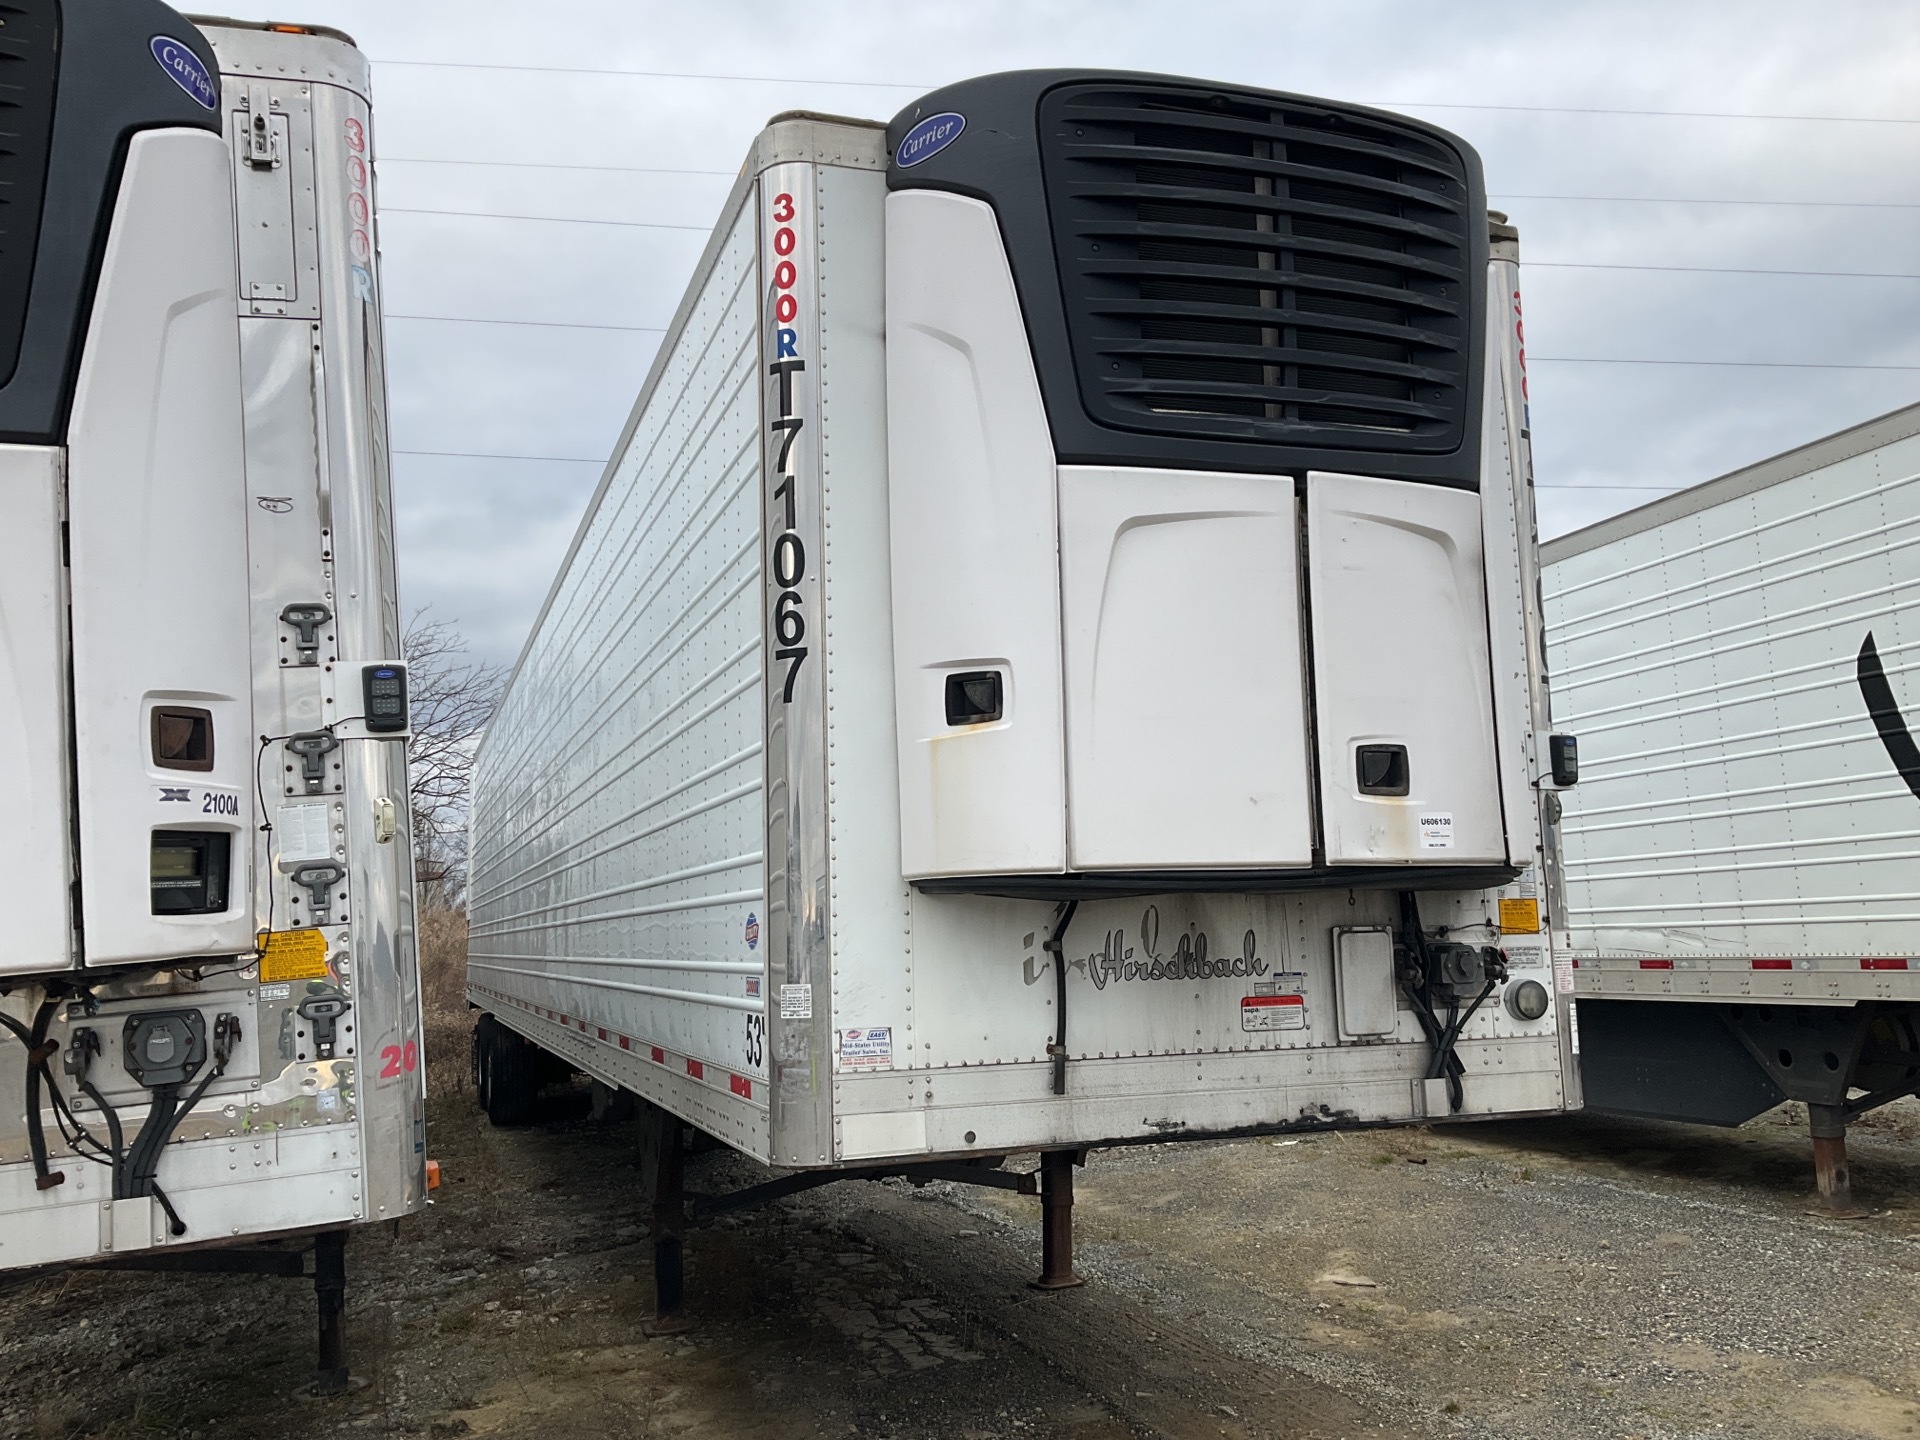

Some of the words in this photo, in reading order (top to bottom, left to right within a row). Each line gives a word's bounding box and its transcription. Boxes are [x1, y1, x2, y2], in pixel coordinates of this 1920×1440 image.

[162, 45, 214, 98] Carrier
[902, 120, 954, 160] Carrier
[773, 192, 798, 359] 3000R
[769, 359, 808, 704] T71067
[202, 792, 239, 816] 2100A
[1421, 818, 1451, 826] U606130
[1088, 929, 1269, 990] Hirschbach
[380, 1040, 417, 1079] 20
